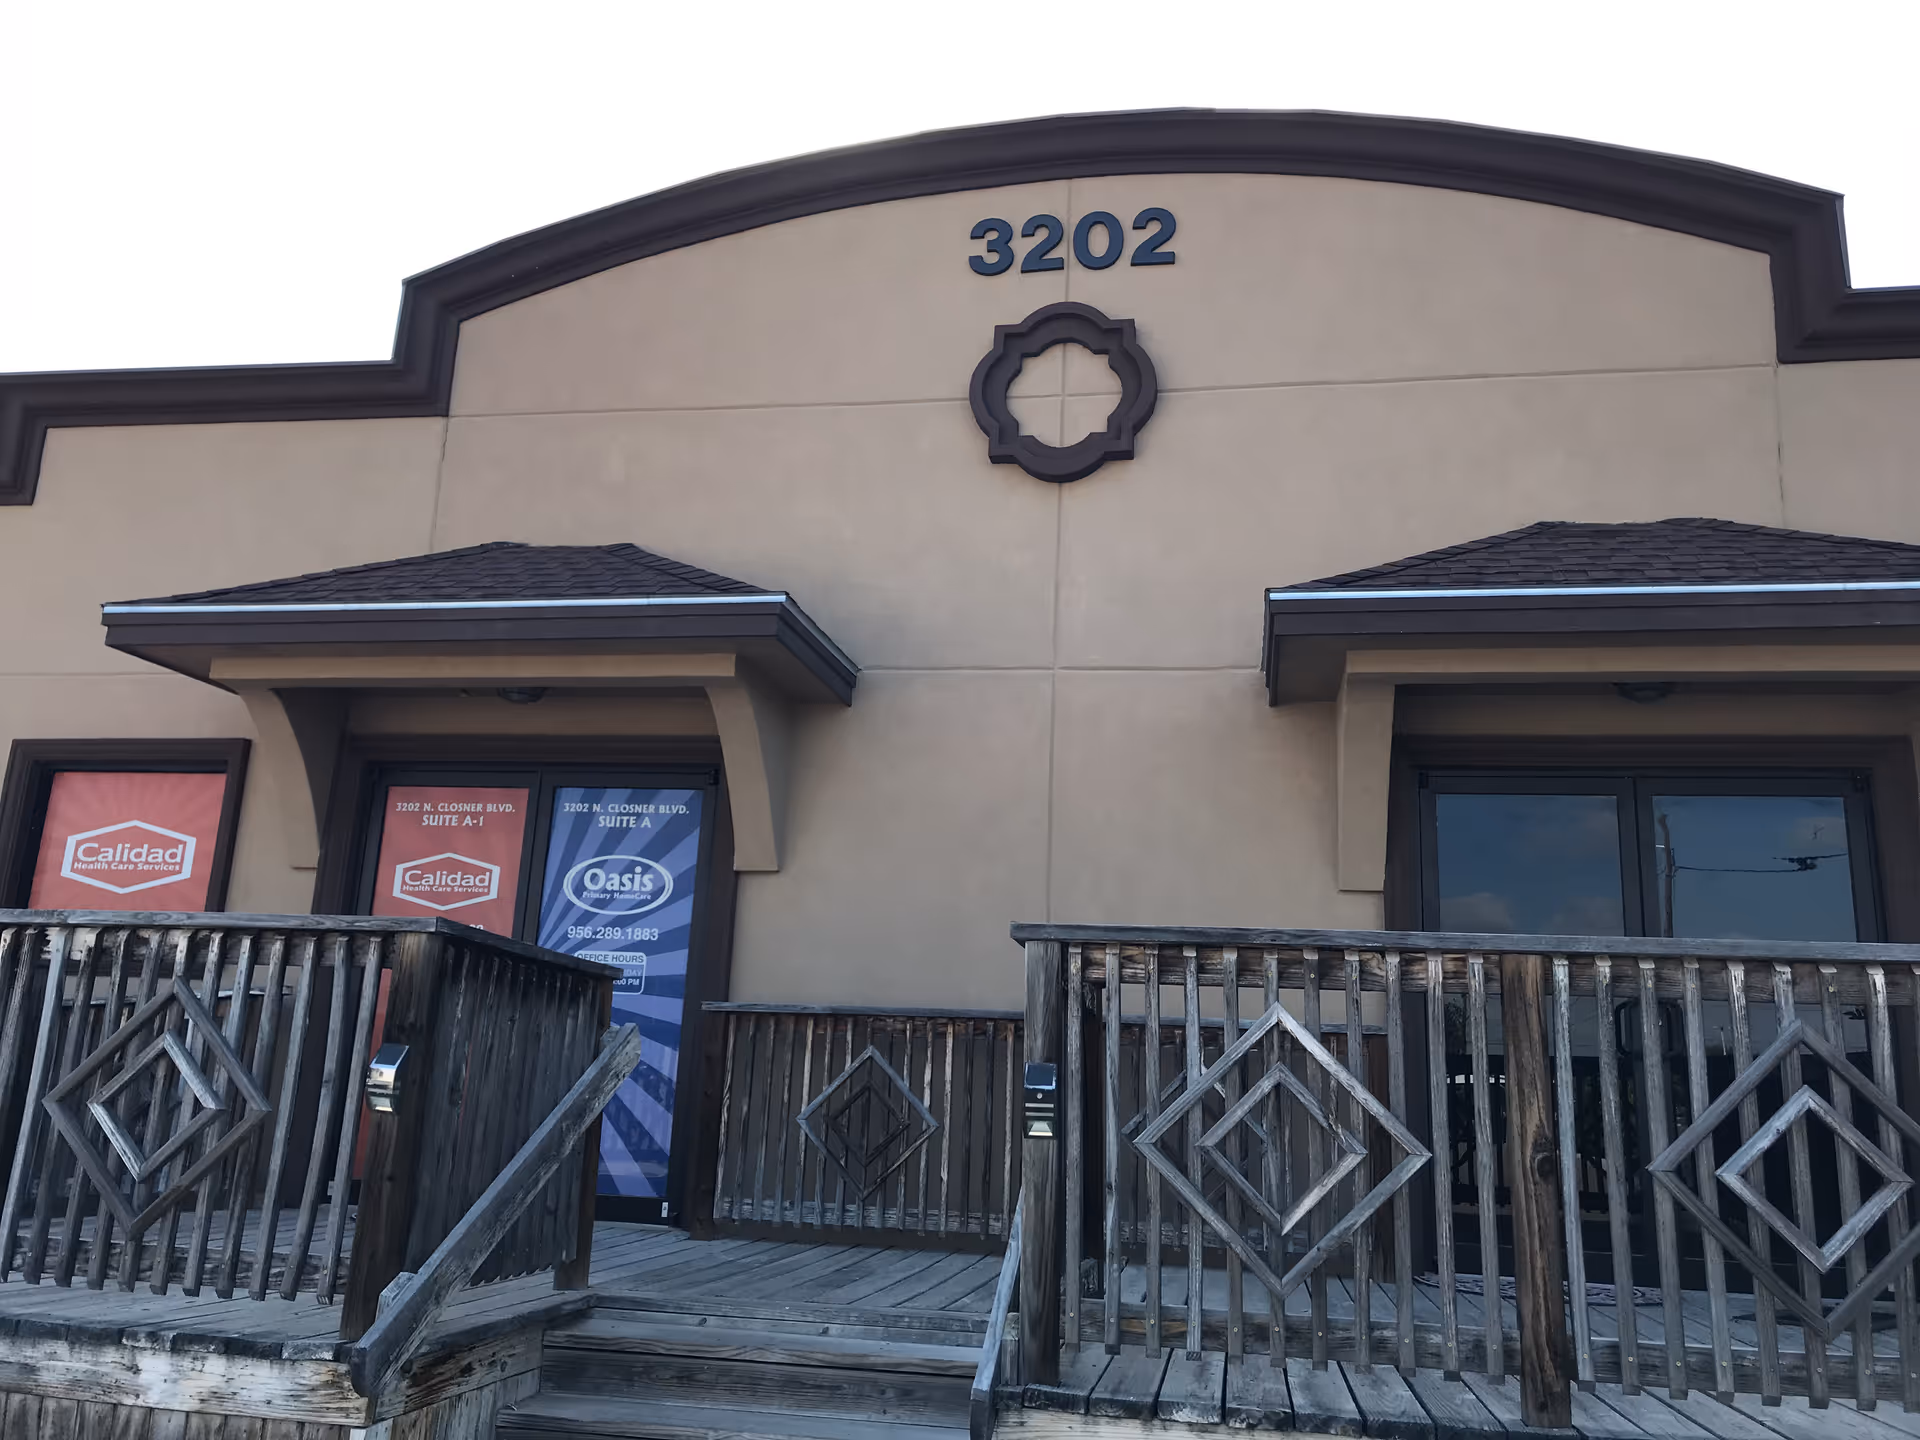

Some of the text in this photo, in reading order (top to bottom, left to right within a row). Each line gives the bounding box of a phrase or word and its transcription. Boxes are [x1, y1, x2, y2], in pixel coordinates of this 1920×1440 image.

[968, 206, 1177, 276] 3202
[395, 802, 515, 813] 3202 N. CLOSNER BLVD.
[563, 802, 690, 815] 3202 N. CLOSNER BLVD.
[421, 814, 484, 827] SUITE A-1
[598, 815, 652, 829] SUITE A
[76, 842, 184, 863] Calidad
[73, 861, 180, 872] Health Care Services
[404, 869, 490, 887] Calidad
[583, 865, 654, 892] Oasis
[402, 884, 431, 892] Health
[432, 885, 452, 893] Care
[582, 891, 652, 900] Primary HomeCare
[567, 925, 659, 941] 956.289.1883
[577, 952, 645, 963] OFFICE HOURS
[627, 978, 640, 986] PM
